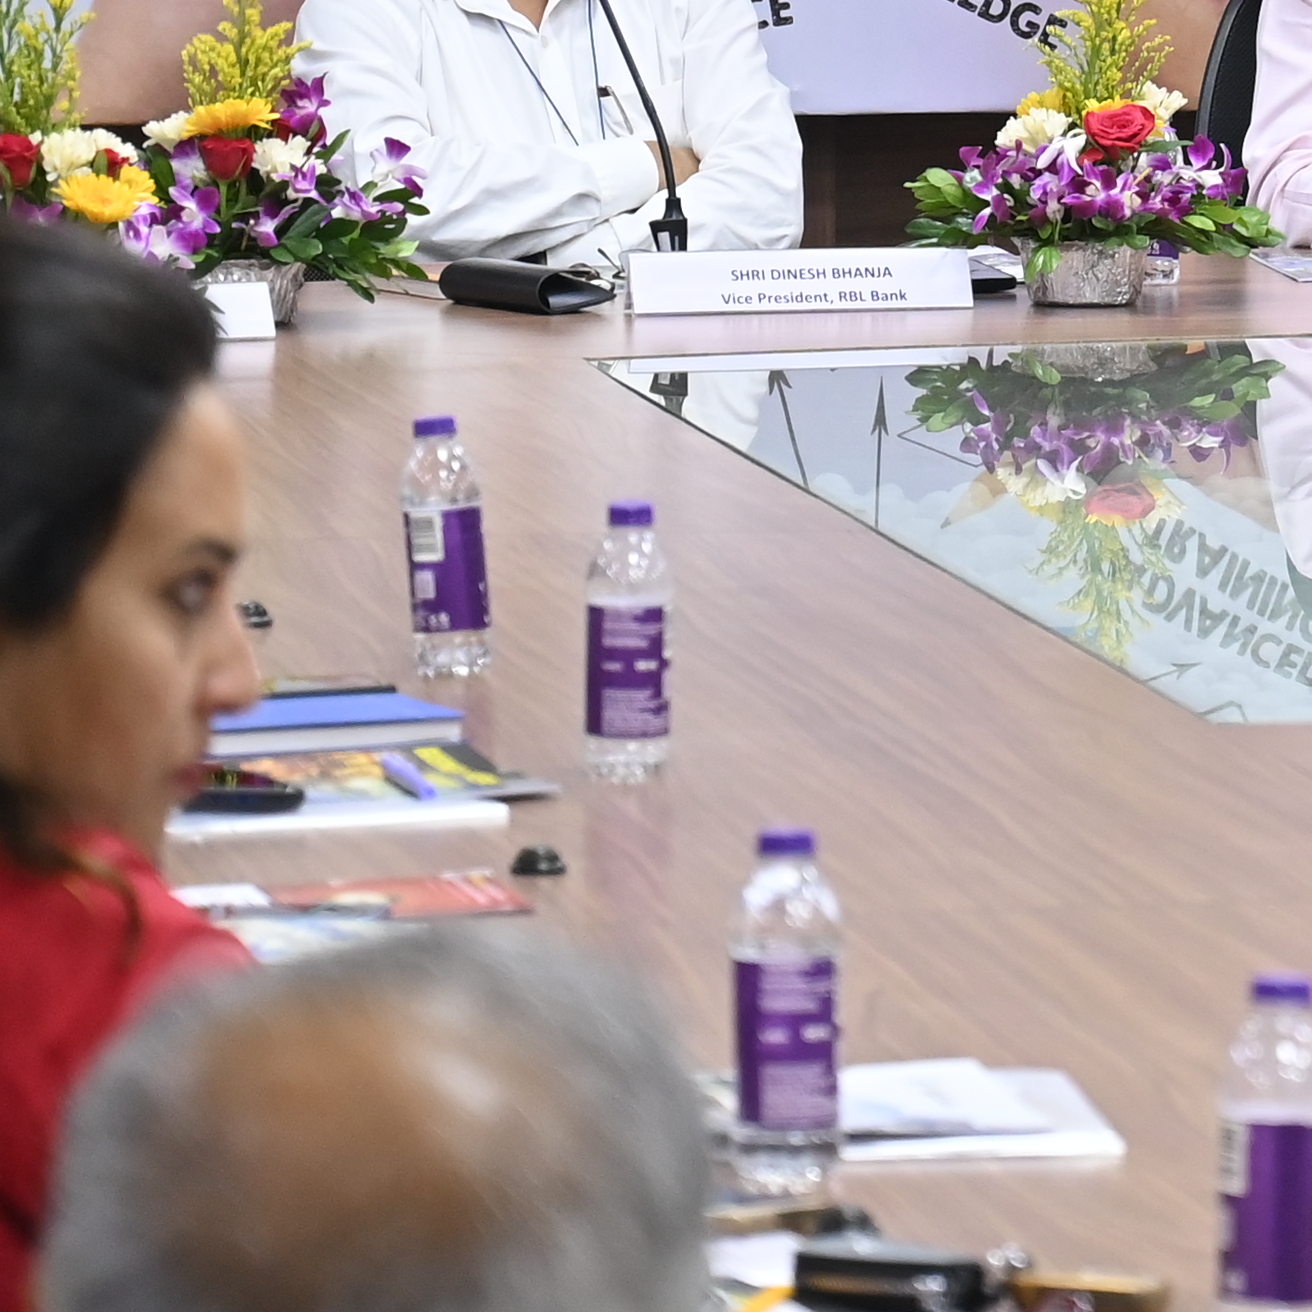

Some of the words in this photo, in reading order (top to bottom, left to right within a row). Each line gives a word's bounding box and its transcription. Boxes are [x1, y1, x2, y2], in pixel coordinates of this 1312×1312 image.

[731, 268, 766, 282] SHRI
[770, 267, 827, 281] DINESH
[832, 266, 893, 280] BHANJA
[721, 293, 754, 305] Vice
[758, 291, 834, 305] President,
[839, 290, 867, 303] RBL
[871, 288, 908, 302] Bank
